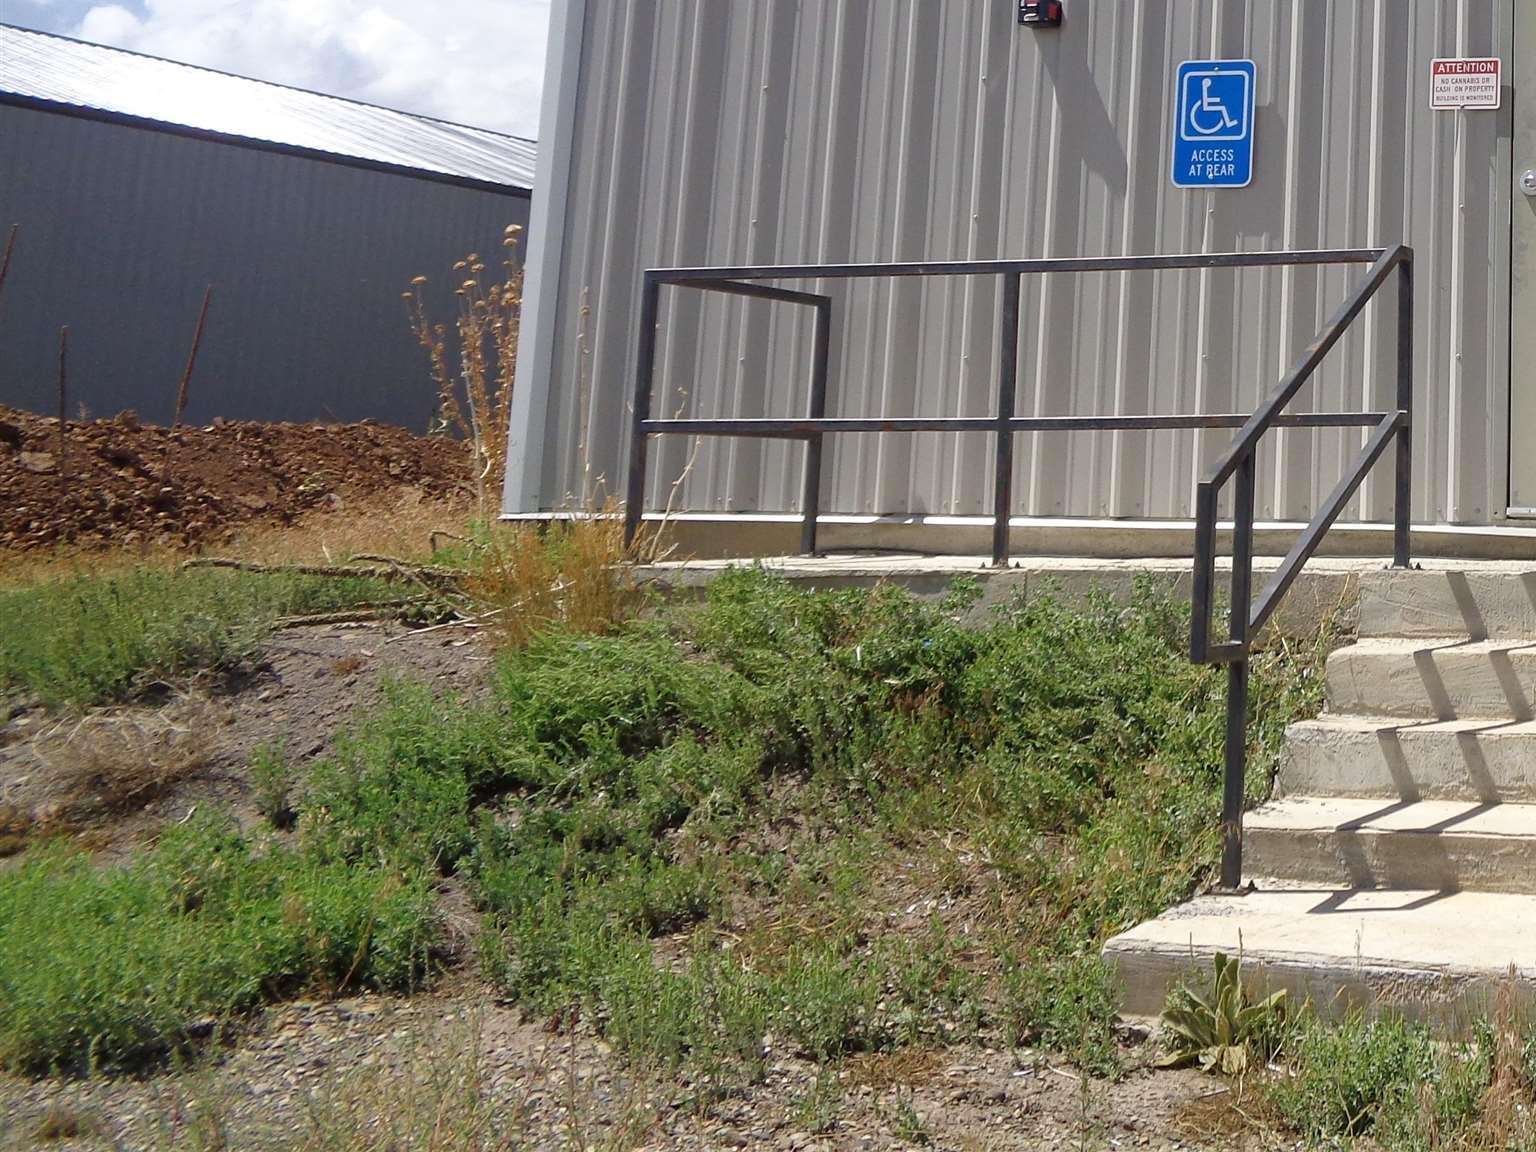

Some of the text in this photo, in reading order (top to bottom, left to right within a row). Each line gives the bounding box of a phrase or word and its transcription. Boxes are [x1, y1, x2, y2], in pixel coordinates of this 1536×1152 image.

[1437, 62, 1495, 73] ATTENTION
[1190, 148, 1235, 162] ACCESS
[1188, 163, 1236, 176] AT REAR
